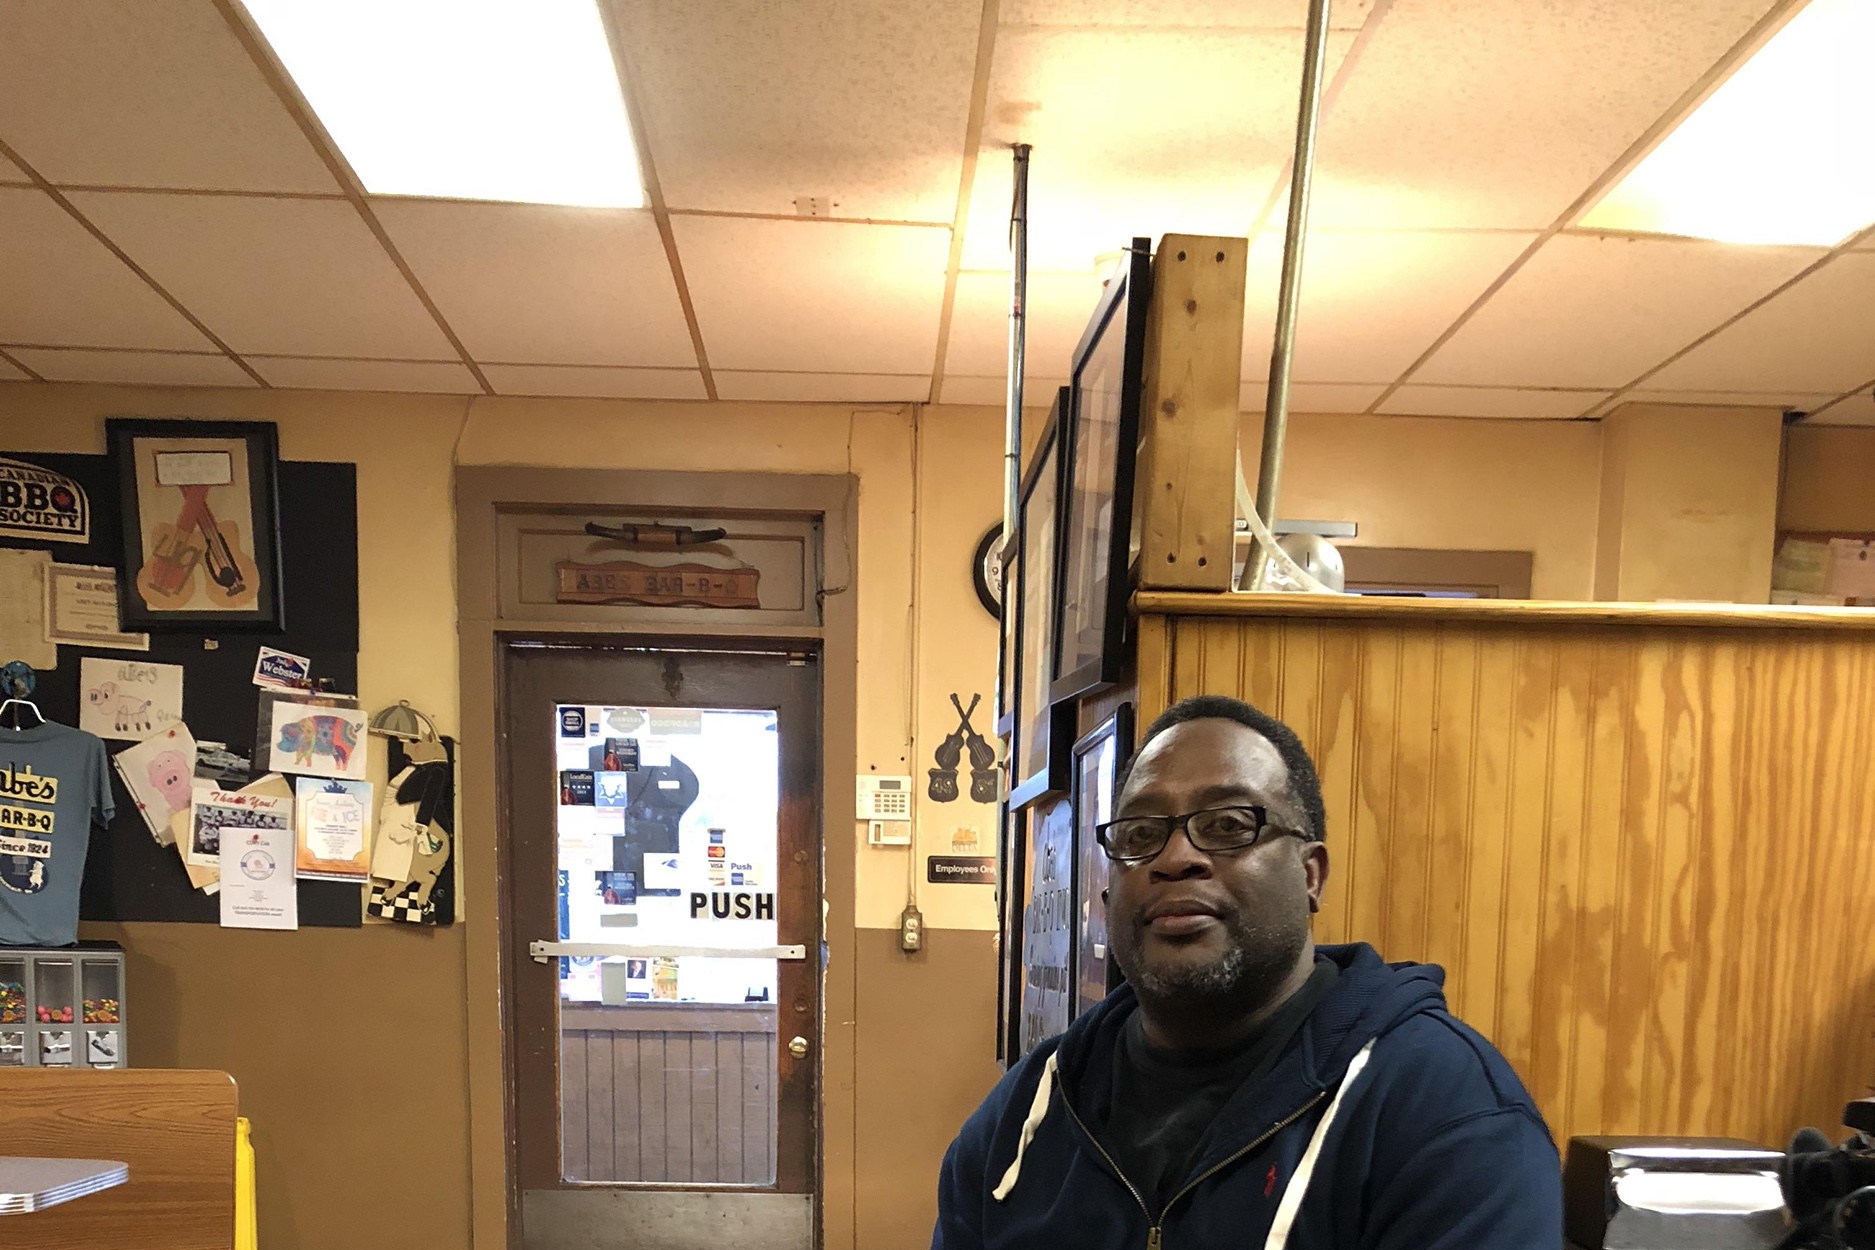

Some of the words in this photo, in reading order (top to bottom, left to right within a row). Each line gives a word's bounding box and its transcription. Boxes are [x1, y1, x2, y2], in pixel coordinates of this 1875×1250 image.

[0, 481, 78, 513] BBQ
[0, 508, 79, 528] SOCIETY
[991, 566, 999, 576] 9
[262, 660, 302, 679] Webster
[931, 777, 953, 794] 49
[210, 791, 247, 804] Thak
[249, 796, 278, 809] You!
[1, 808, 51, 831] AR-B-Q
[0, 838, 26, 852] ince
[27, 842, 49, 854] 1924
[935, 864, 979, 875] Employees
[690, 891, 774, 920] PUSH
